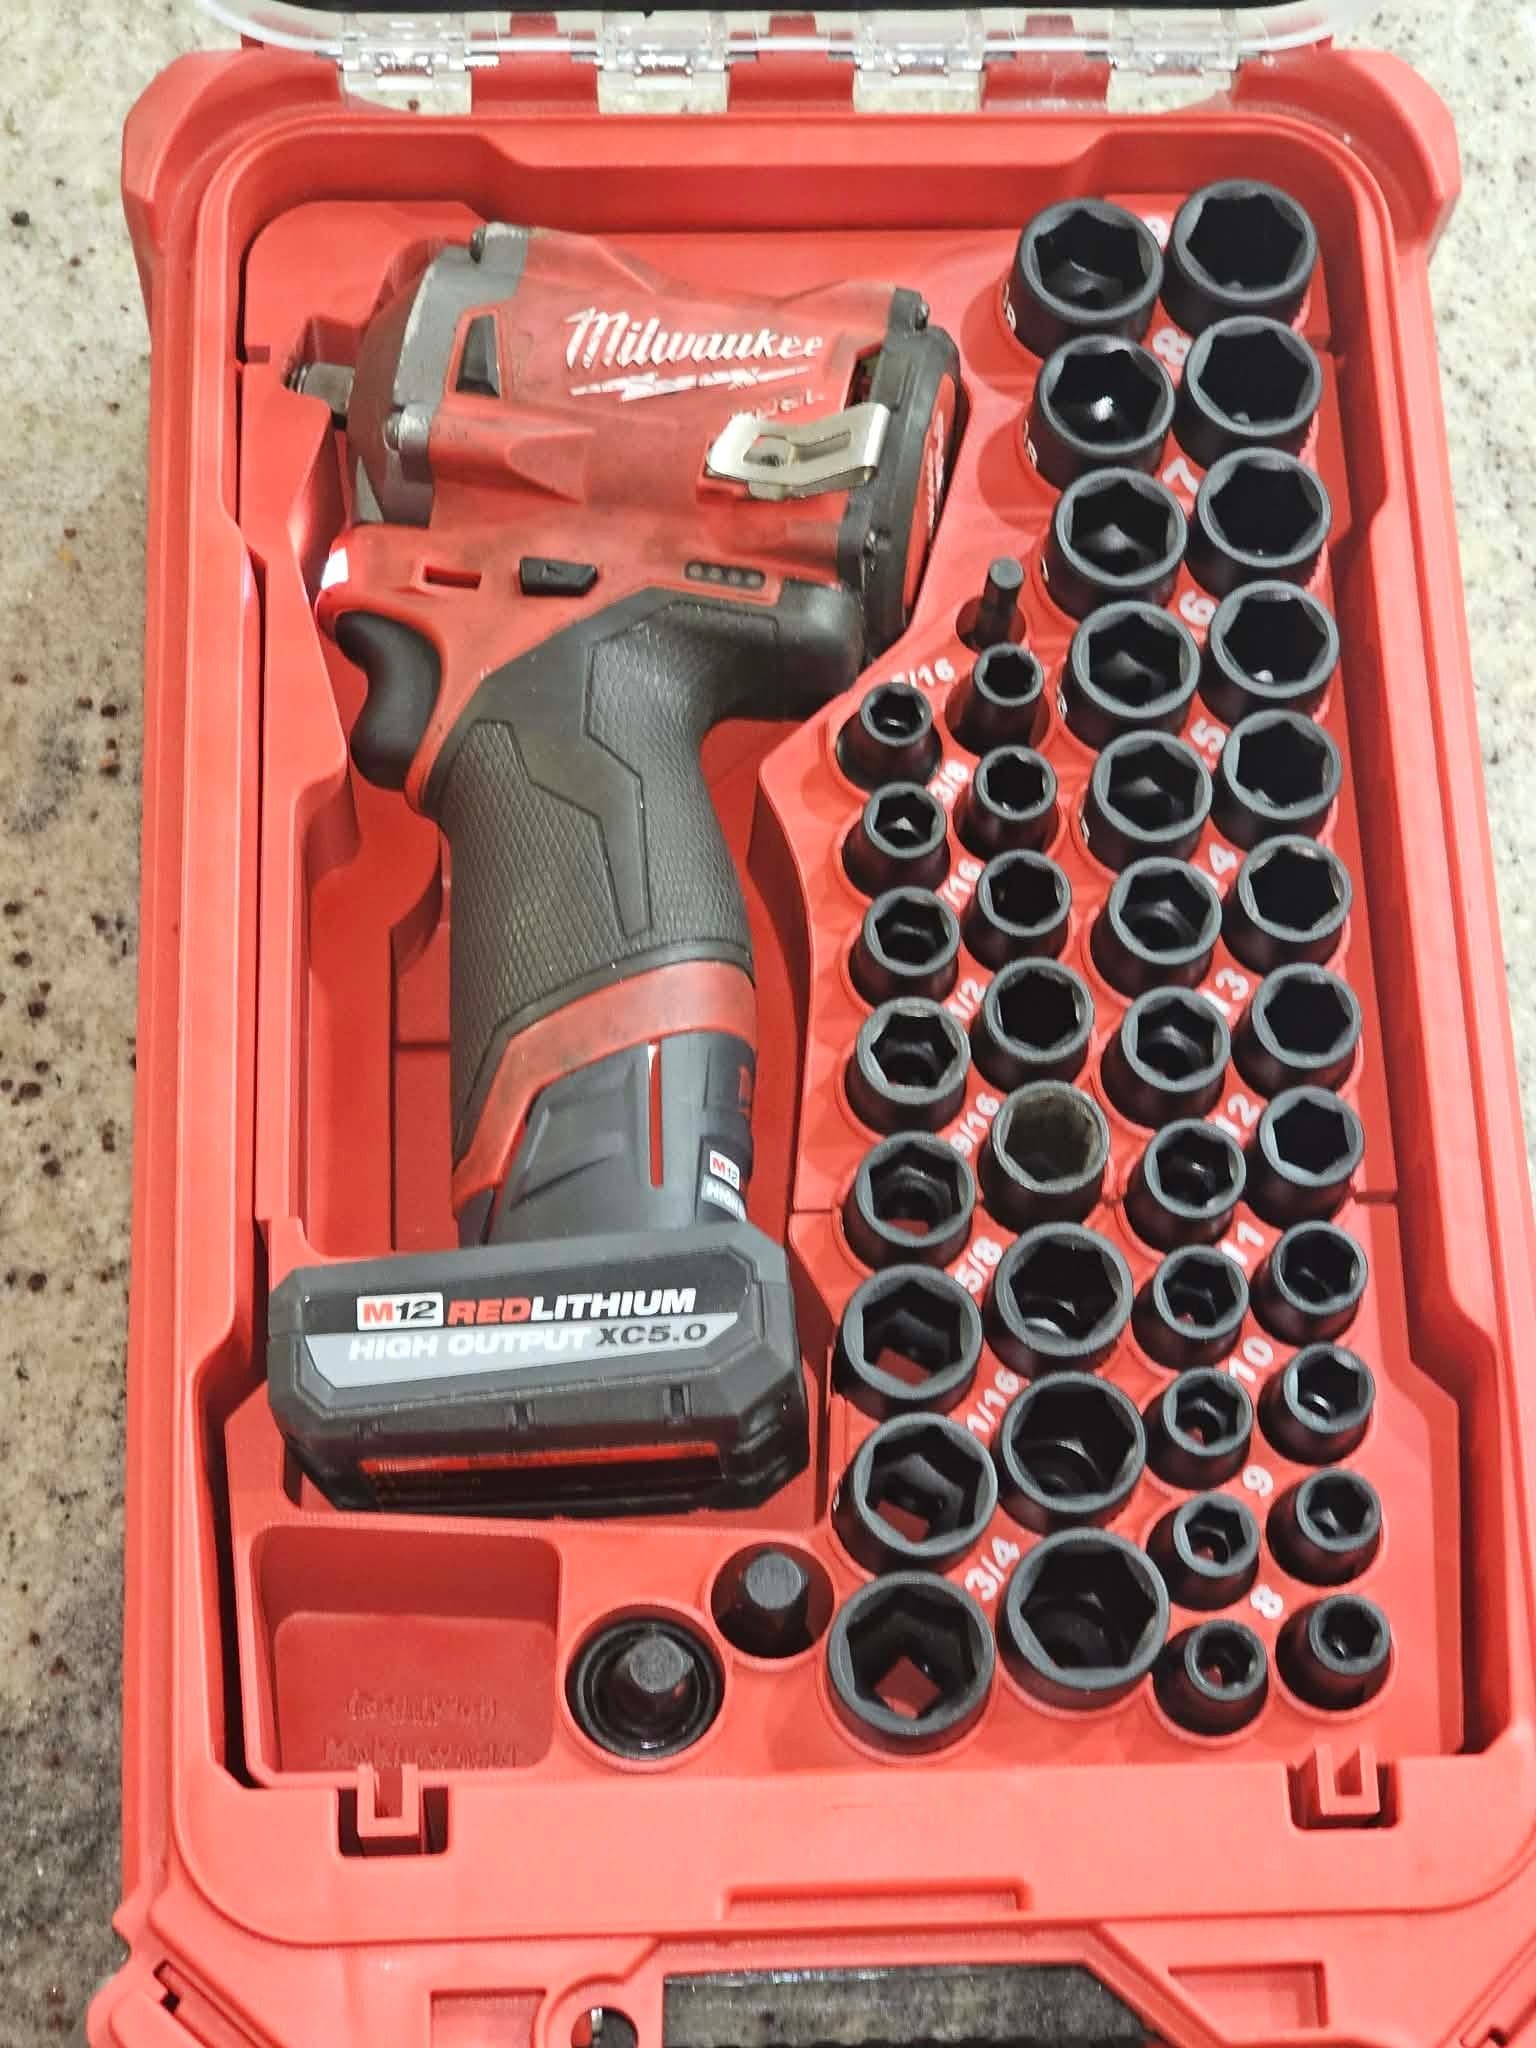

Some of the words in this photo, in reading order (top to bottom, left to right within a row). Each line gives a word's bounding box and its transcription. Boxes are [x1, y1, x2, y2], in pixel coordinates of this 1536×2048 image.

[565, 306, 823, 369] Milwaukee
[1215, 1093, 1260, 1137] 12
[954, 1237, 1003, 1294] 5/8
[362, 1299, 437, 1325] M12
[448, 1288, 697, 1325] REDLITHIUM
[349, 1331, 437, 1360] HIGH
[448, 1327, 592, 1355] OUTPUT
[596, 1322, 708, 1348] XC5.0
[1228, 1336, 1274, 1384] 10
[1241, 1464, 1274, 1497] 9
[964, 1536, 1020, 1601] 3/4
[1250, 1584, 1284, 1620] 8
